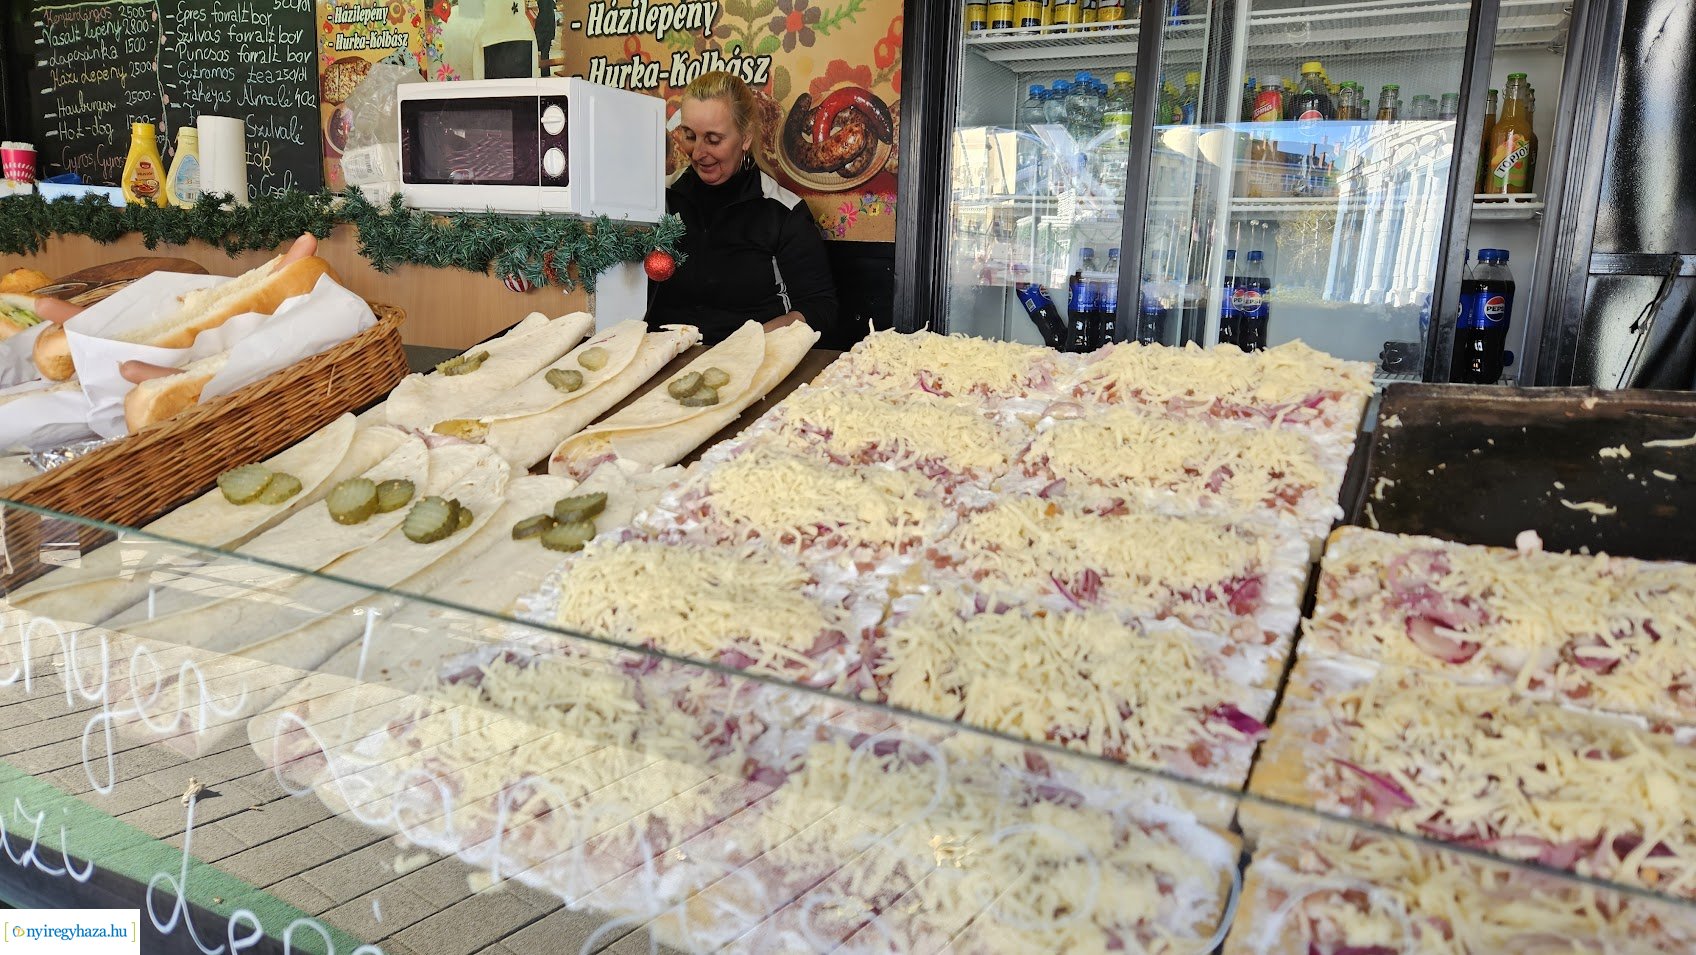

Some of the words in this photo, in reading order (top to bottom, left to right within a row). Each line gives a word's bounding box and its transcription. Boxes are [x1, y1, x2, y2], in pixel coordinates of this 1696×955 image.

[176, 1, 206, 26] Epres
[250, 4, 272, 26] bor
[334, 2, 389, 26] Házilepény
[587, 0, 718, 41] Házilepény
[176, 21, 221, 44] Szilvás
[279, 25, 303, 44] bor
[335, 28, 409, 51] Hurka-Kolbász
[286, 45, 312, 63] bor
[177, 61, 235, 81] Citromos
[247, 67, 275, 83] tea
